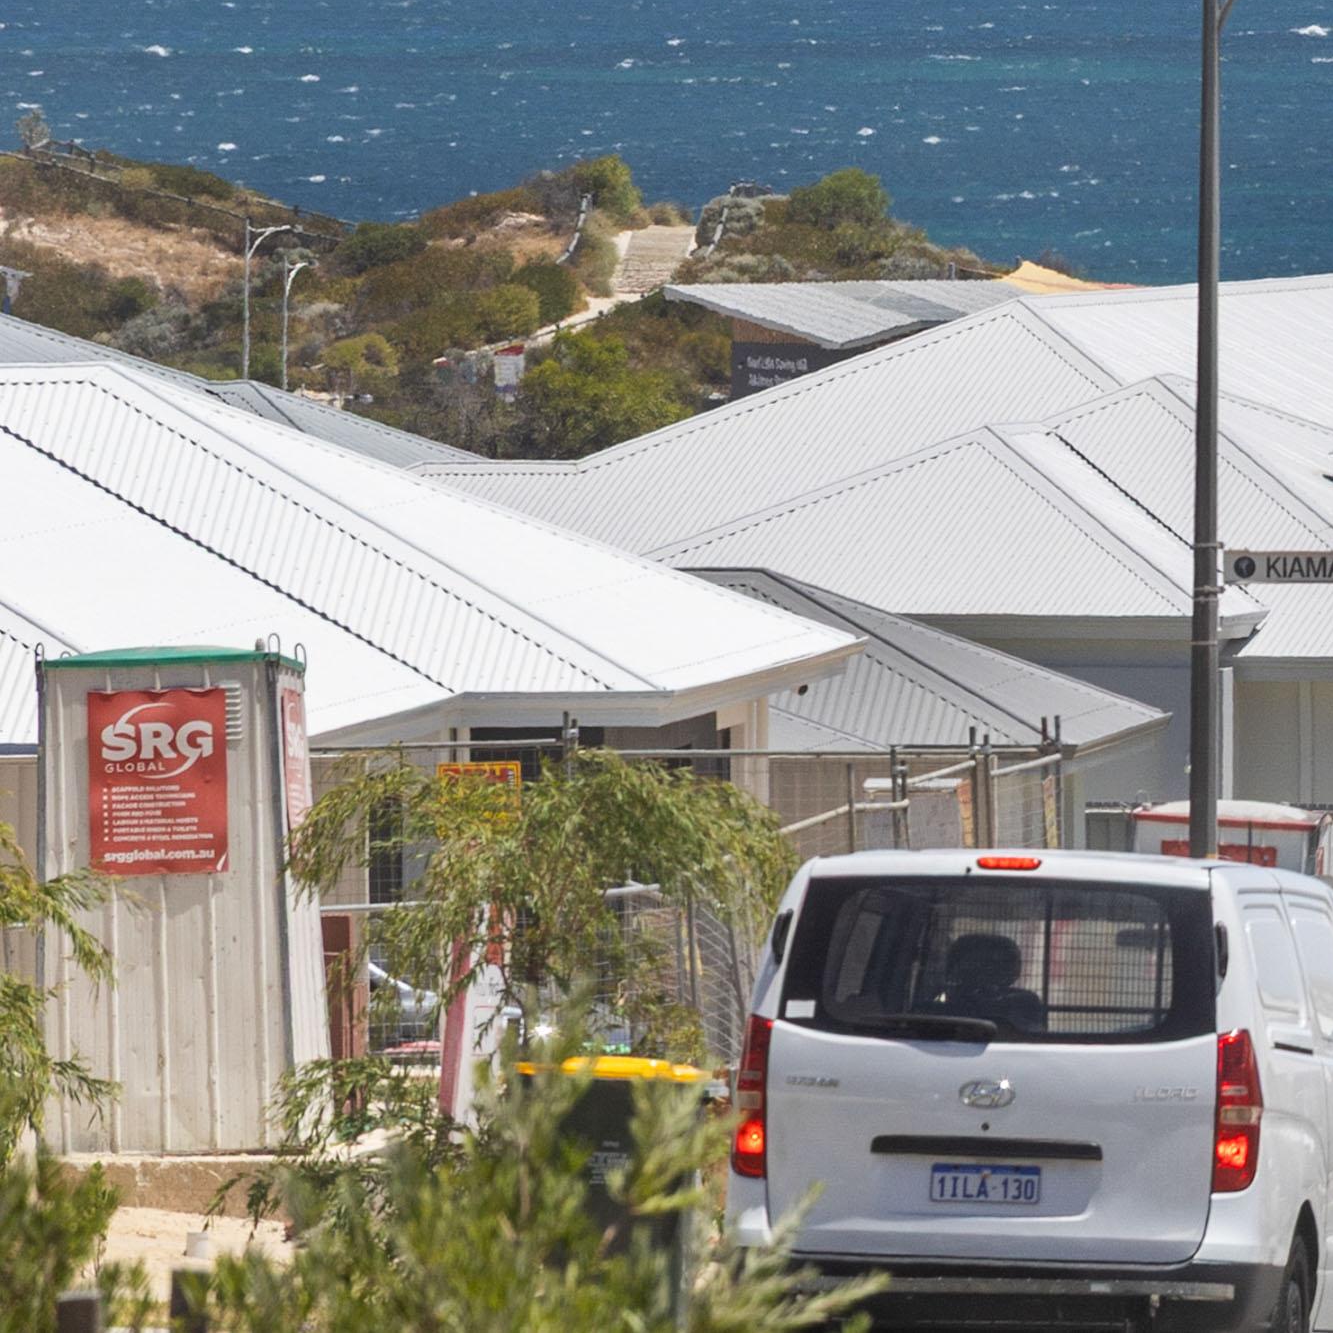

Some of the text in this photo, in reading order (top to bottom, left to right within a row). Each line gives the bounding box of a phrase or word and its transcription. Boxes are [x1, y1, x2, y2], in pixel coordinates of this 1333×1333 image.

[101, 719, 213, 763] SRG
[104, 761, 166, 773] GLOBAL
[104, 849, 215, 863] srgglobal.com.au
